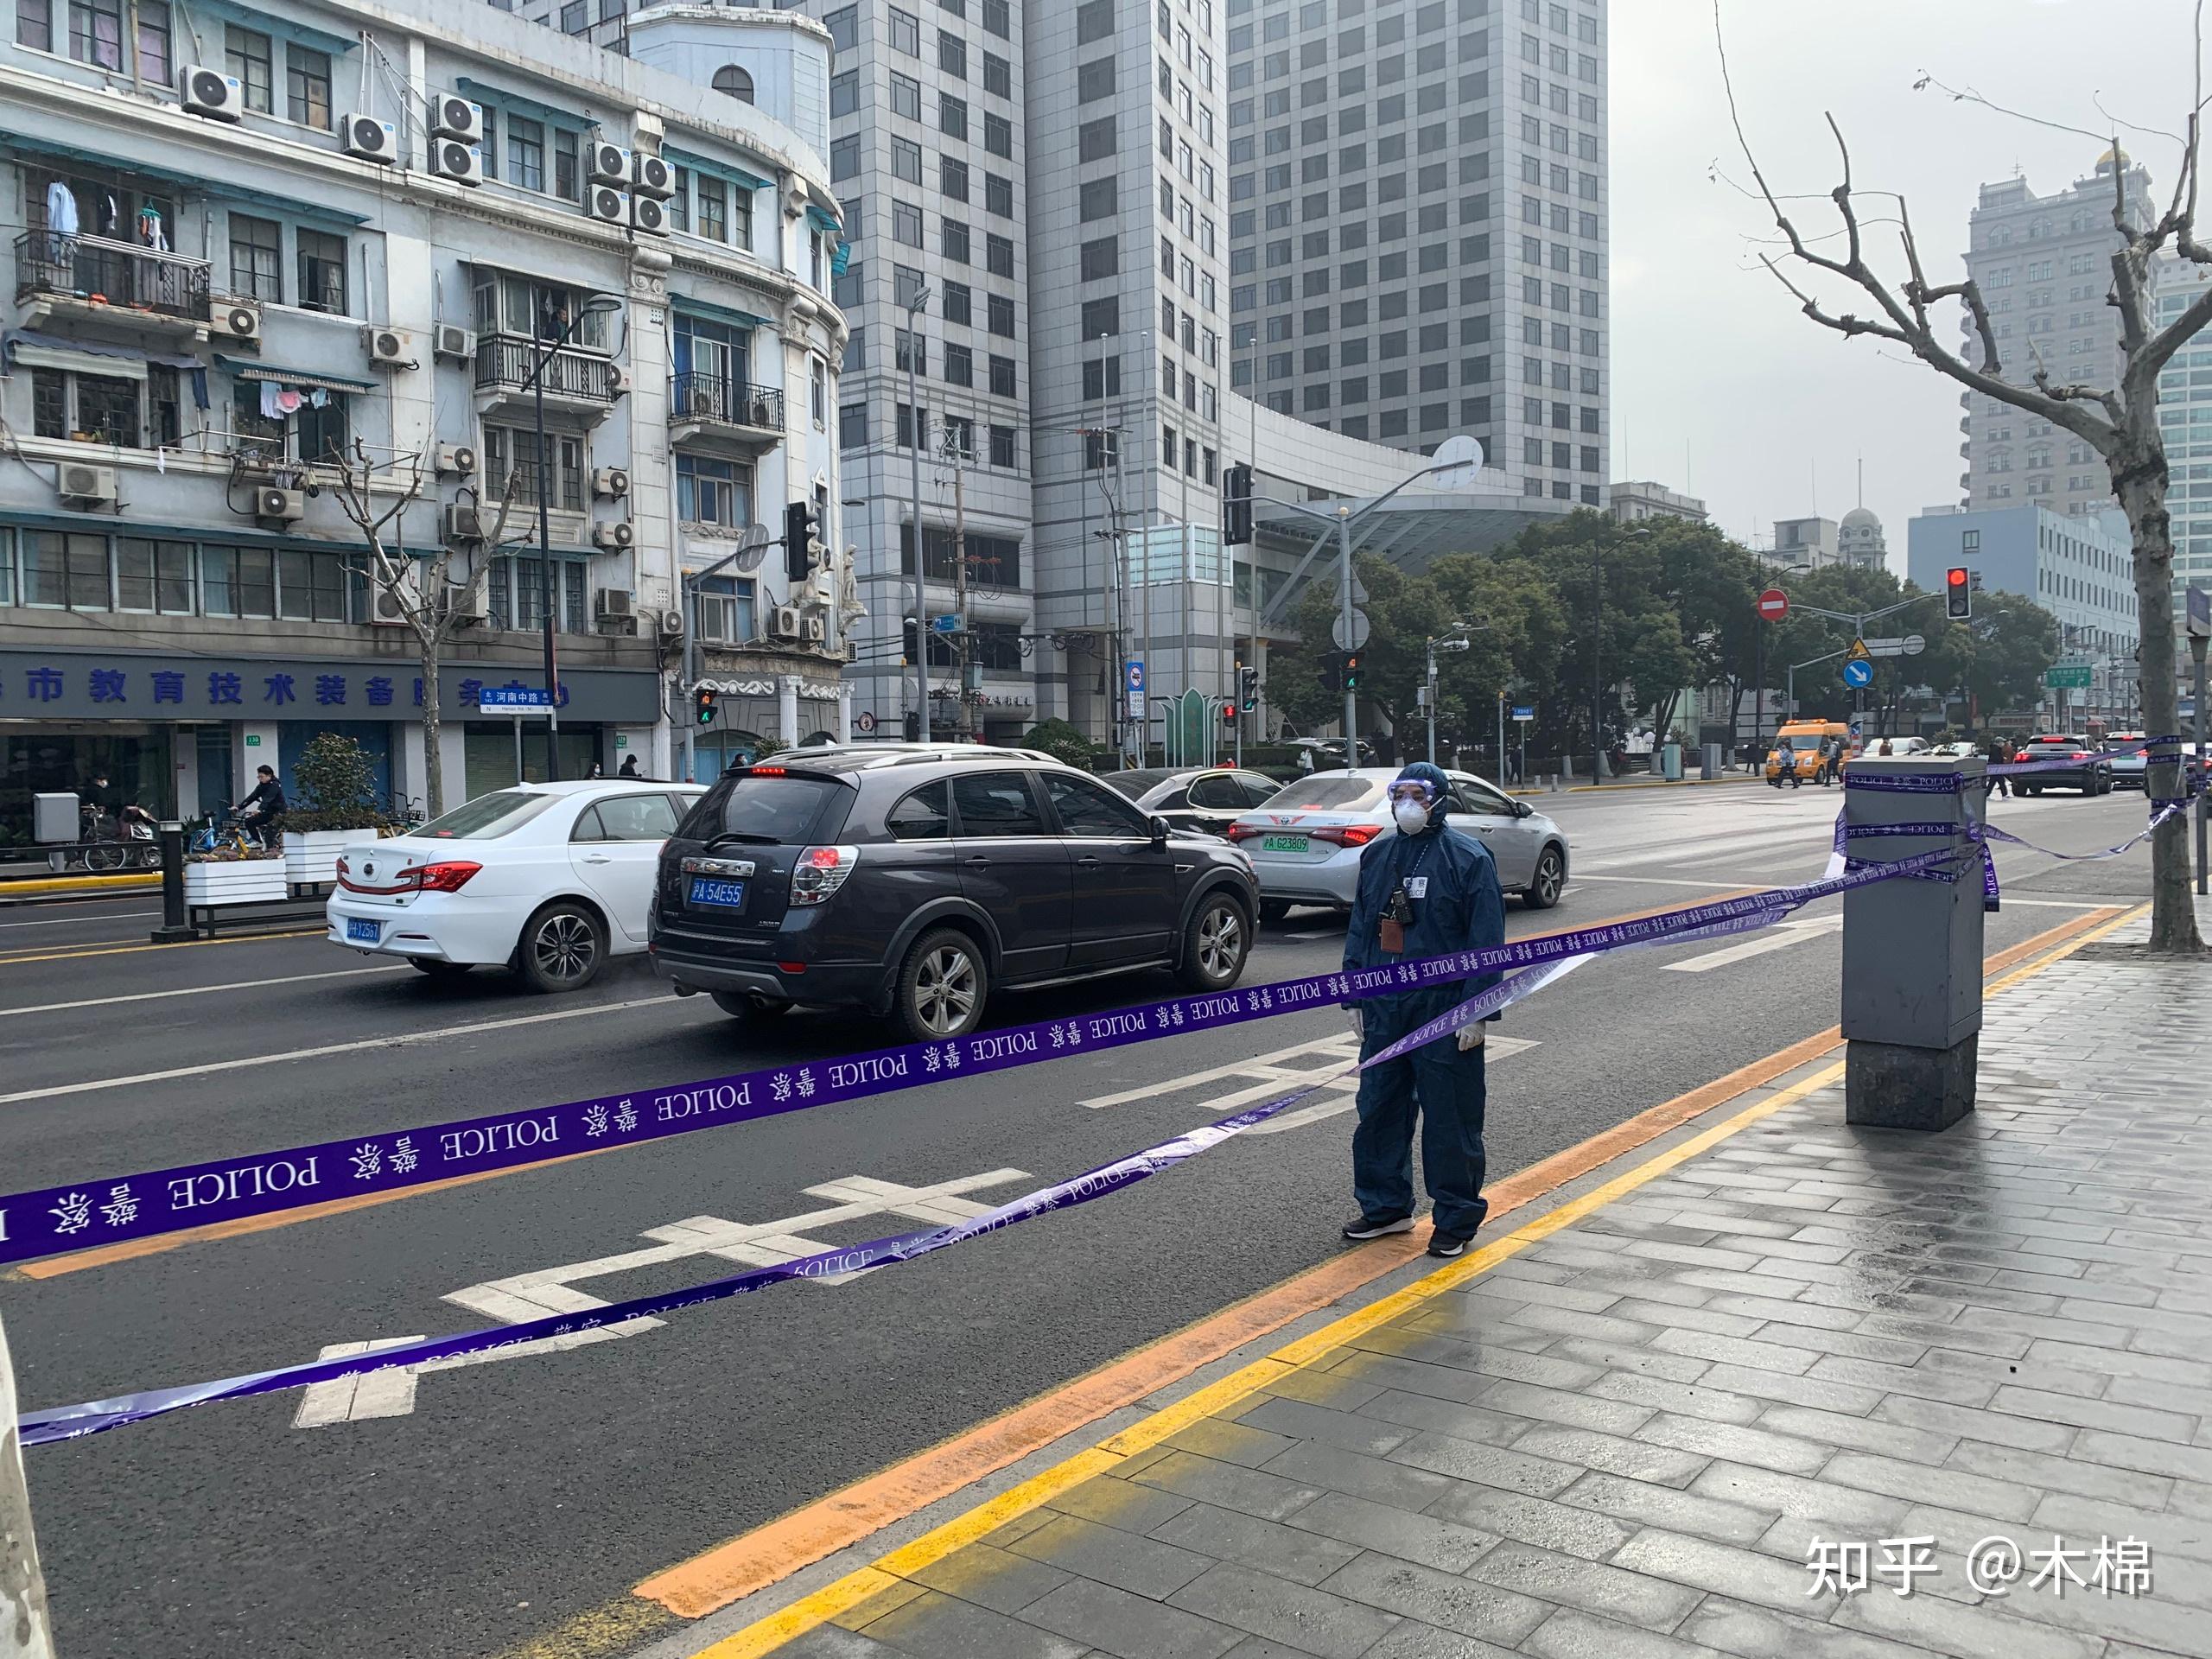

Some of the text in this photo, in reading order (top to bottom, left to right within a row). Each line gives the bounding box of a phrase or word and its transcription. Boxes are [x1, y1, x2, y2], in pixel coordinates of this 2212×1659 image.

[0, 667, 569, 708] 市教育技术装备务
[496, 691, 538, 703] 河南中路
[1481, 948, 1512, 966] POLICE
[1534, 939, 1563, 956] POLICE
[1353, 969, 1393, 989] POLICE
[1421, 958, 1456, 977] POLICE
[1277, 982, 1321, 1003] POLICE
[1155, 1003, 1184, 1028] 警察
[1190, 996, 1240, 1020] POLICE
[1049, 1021, 1082, 1048] 警察
[1090, 1013, 1147, 1038] POLICE
[922, 1042, 961, 1072] 警察
[971, 1032, 1038, 1061] POLICE
[769, 1068, 816, 1102] 警察
[829, 1054, 909, 1088] POLICE
[655, 1083, 752, 1121] POLICE
[582, 1098, 639, 1137] 警察
[440, 1116, 560, 1160] POLICE
[348, 1135, 421, 1179] 警察
[168, 1156, 321, 1211] POLICE
[48, 1183, 142, 1234] 警察
